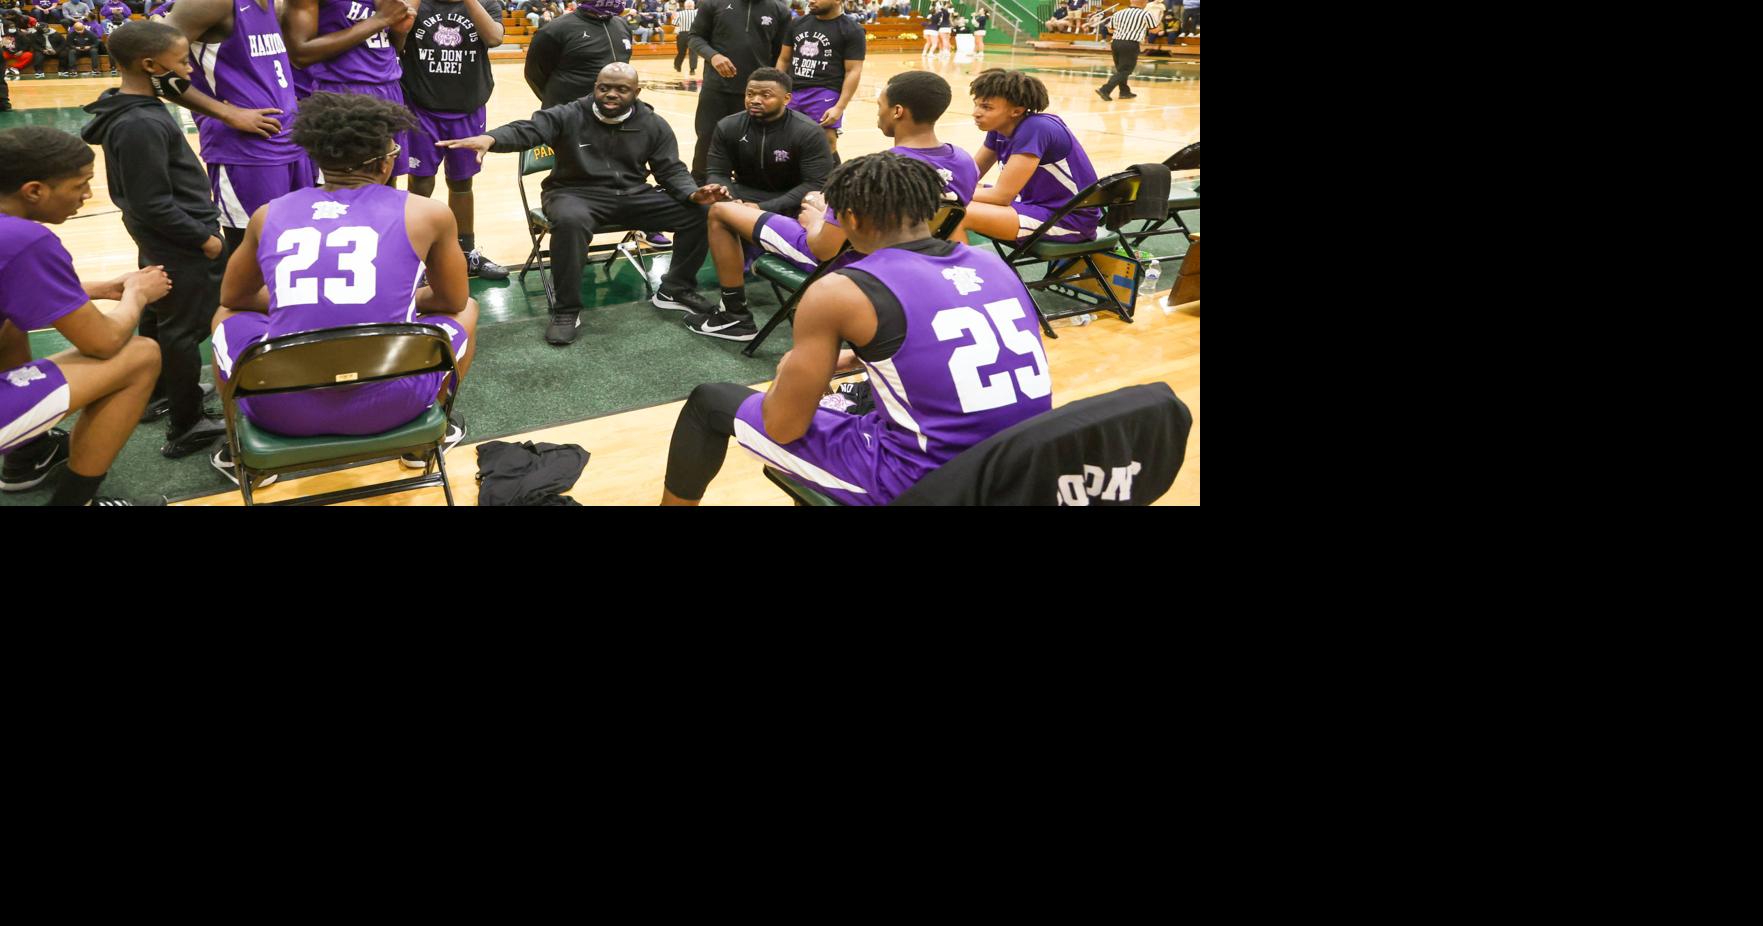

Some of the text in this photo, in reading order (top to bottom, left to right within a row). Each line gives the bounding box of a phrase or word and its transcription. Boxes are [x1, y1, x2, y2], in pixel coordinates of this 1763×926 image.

[415, 13, 479, 43] NO ONE LIKES US
[795, 31, 809, 42] ONE
[812, 31, 831, 47] LIKES
[418, 48, 477, 62] WE DON'T
[429, 61, 462, 75] CARE!
[794, 66, 815, 78] CARE!
[801, 58, 828, 71] DON'T
[273, 59, 288, 89] 3
[275, 226, 379, 308] 23
[931, 297, 1052, 414] 25
[840, 383, 854, 393] NO
